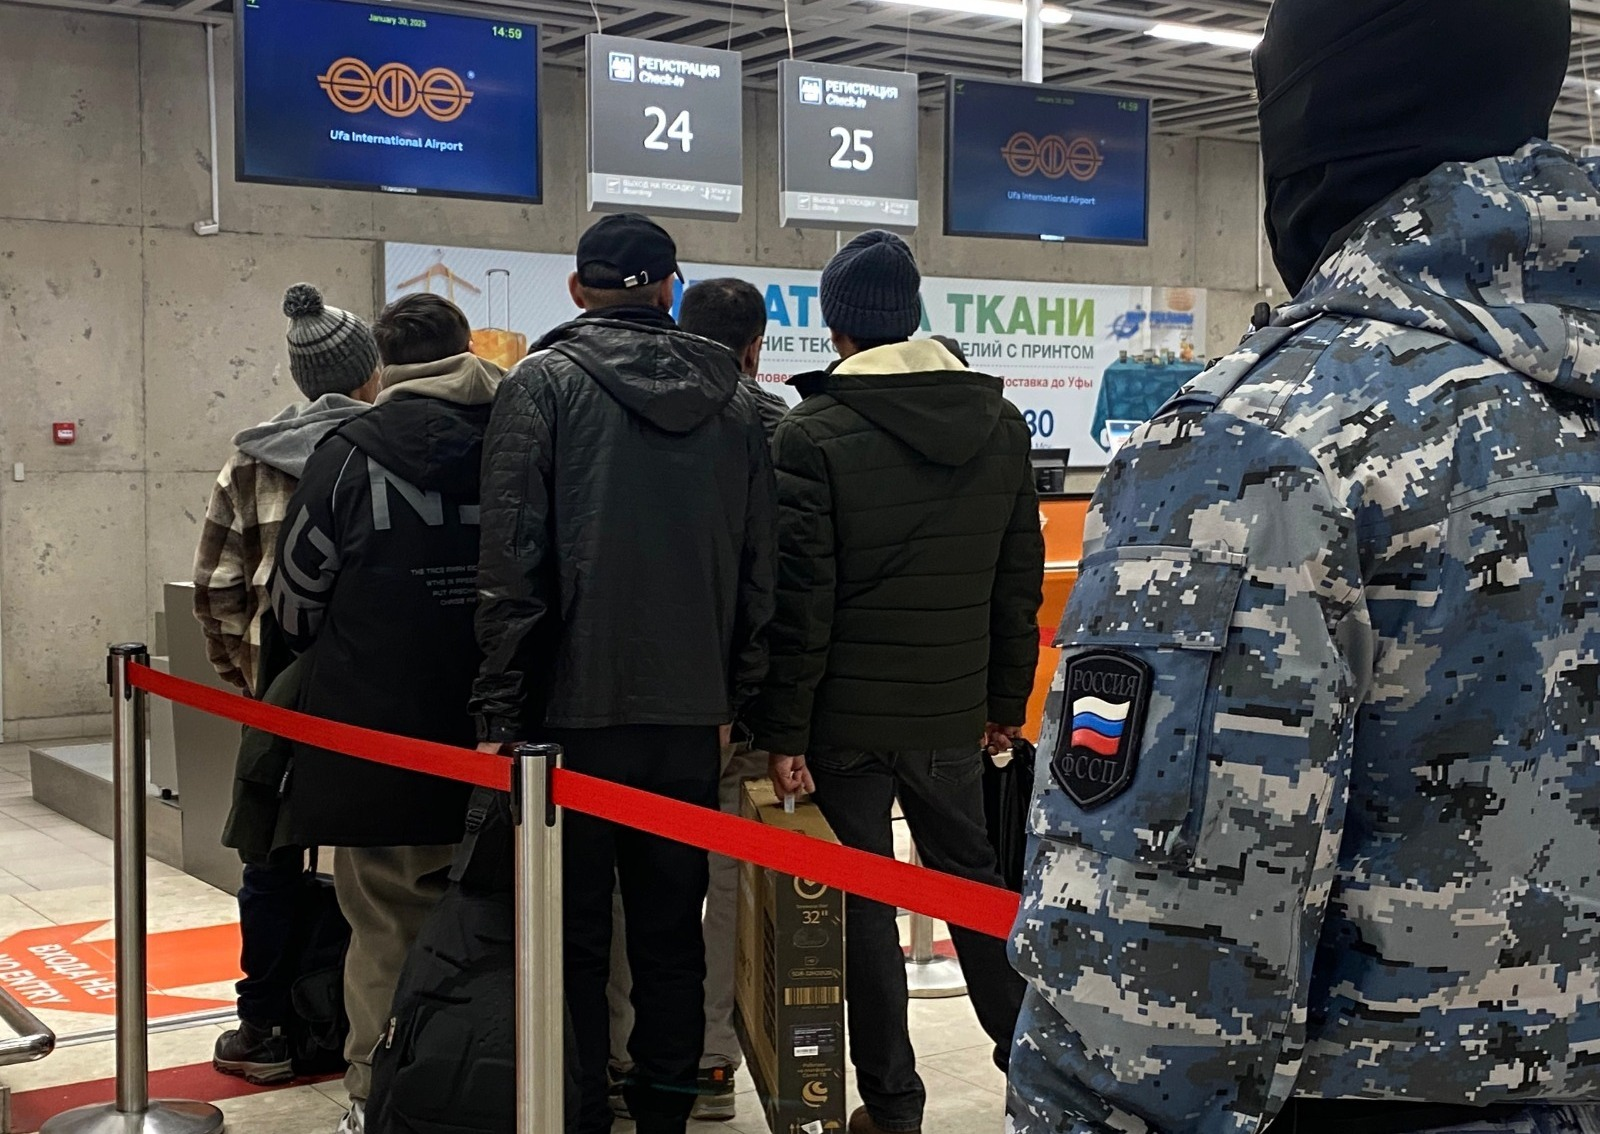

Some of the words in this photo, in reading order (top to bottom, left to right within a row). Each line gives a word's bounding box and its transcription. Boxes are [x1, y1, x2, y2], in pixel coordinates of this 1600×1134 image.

[368, 13, 396, 26] January
[492, 26, 522, 39] 14:59
[638, 56, 720, 78] РЕГИСТРАЦИЯ
[638, 72, 684, 88] Check-in
[825, 79, 898, 99] РЕГИСТРАЦИЯ
[825, 93, 867, 109] Check-in
[643, 106, 694, 152] 24
[330, 129, 350, 141] Ufa
[352, 132, 423, 149] International
[424, 138, 463, 152] Airport
[829, 126, 874, 171] 25
[1007, 191, 1021, 200] Ufa
[1022, 191, 1069, 204] International
[1070, 195, 1095, 206] Airport
[947, 293, 1095, 337] ТКАНИ
[762, 336, 795, 353] НИЕ
[961, 340, 1002, 358] ЕЛИЙ
[1006, 343, 1018, 358] С
[1022, 344, 1094, 360] ПРИНТОМ
[1051, 378, 1065, 389] до
[1067, 376, 1093, 390] Уфы
[1072, 669, 1138, 697] РОССИЯ
[1061, 753, 1118, 785] ФССП
[802, 909, 829, 925] 32"
[27, 944, 98, 980] ВХОДА
[0, 969, 71, 1005] ENTRY
